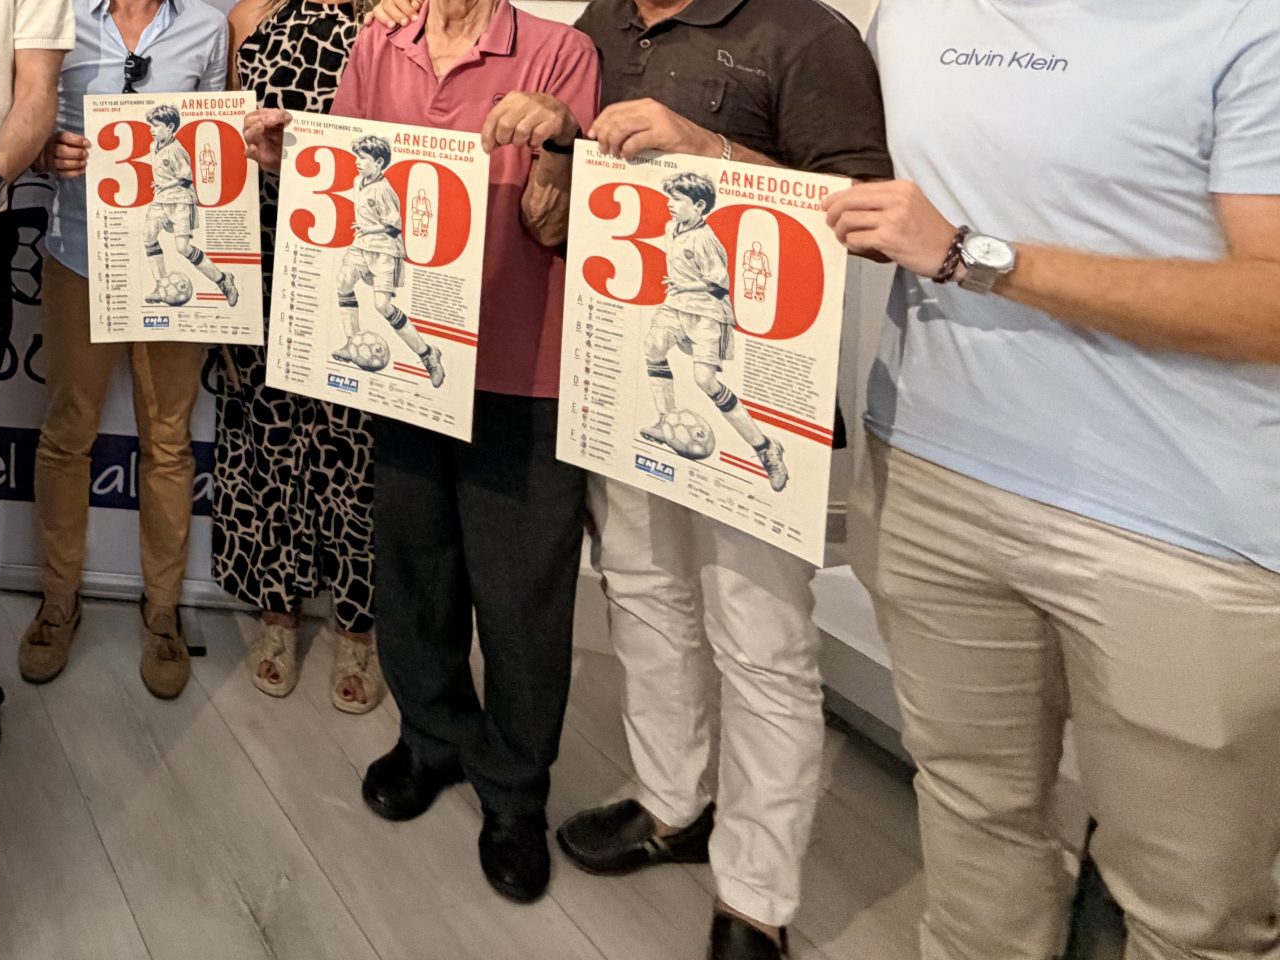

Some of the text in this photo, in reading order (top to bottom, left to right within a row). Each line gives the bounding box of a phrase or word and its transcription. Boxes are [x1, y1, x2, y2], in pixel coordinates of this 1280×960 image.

[940, 48, 1068, 71] Calvin Klein
[182, 98, 245, 109] ARNEDOCUP
[323, 122, 351, 132] SEPTIEMBRE
[394, 133, 475, 154] ARNEDOCUP
[97, 119, 248, 208] 30
[393, 147, 421, 156] CUIDAD
[439, 153, 475, 163] CALZADO
[586, 159, 610, 169] INFANTIL
[664, 161, 678, 169] 2026
[719, 170, 829, 201] ARNEDOCUP
[289, 145, 471, 268] 30
[719, 187, 827, 211] CUIDAD DEL CALZAD
[582, 182, 825, 340] 30
[636, 456, 674, 478] EMKA
